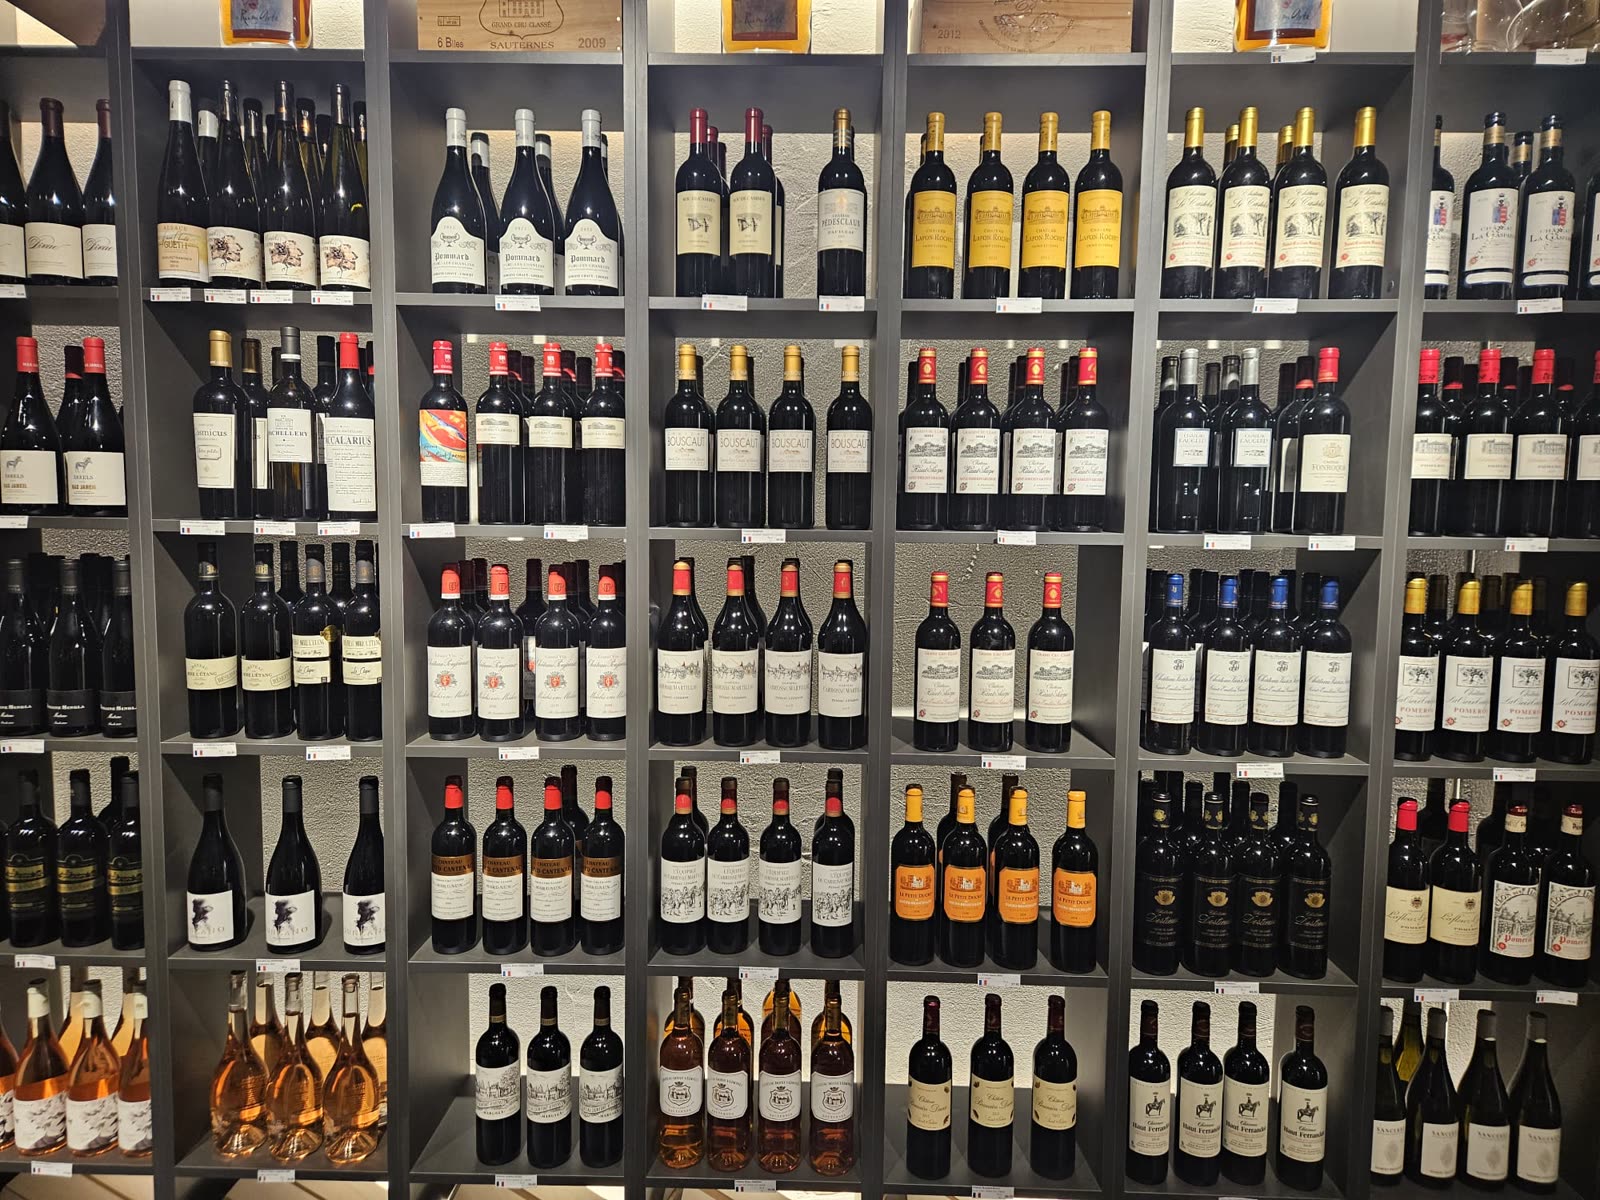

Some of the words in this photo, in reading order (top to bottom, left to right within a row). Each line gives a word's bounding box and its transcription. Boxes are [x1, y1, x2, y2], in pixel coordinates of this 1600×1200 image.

[529, 20, 552, 28] CLASSÉ
[938, 30, 961, 39] 2012
[438, 38, 442, 48] 6
[490, 41, 554, 49] SAUTERNES
[578, 38, 606, 49] 2009
[435, 252, 469, 262] Pommard
[505, 253, 541, 262] Pommard
[570, 254, 606, 264] Pommard
[667, 436, 705, 447] BOUSCAUT
[720, 437, 759, 448] BOUSCAUT
[772, 437, 810, 448] BOUSCAUT
[830, 437, 869, 449] BOUSCAUT
[1132, 1122, 1147, 1132] Haut
[1182, 1123, 1197, 1132] Haut
[1225, 1121, 1240, 1132] Haut
[1283, 1126, 1298, 1136] Haut
